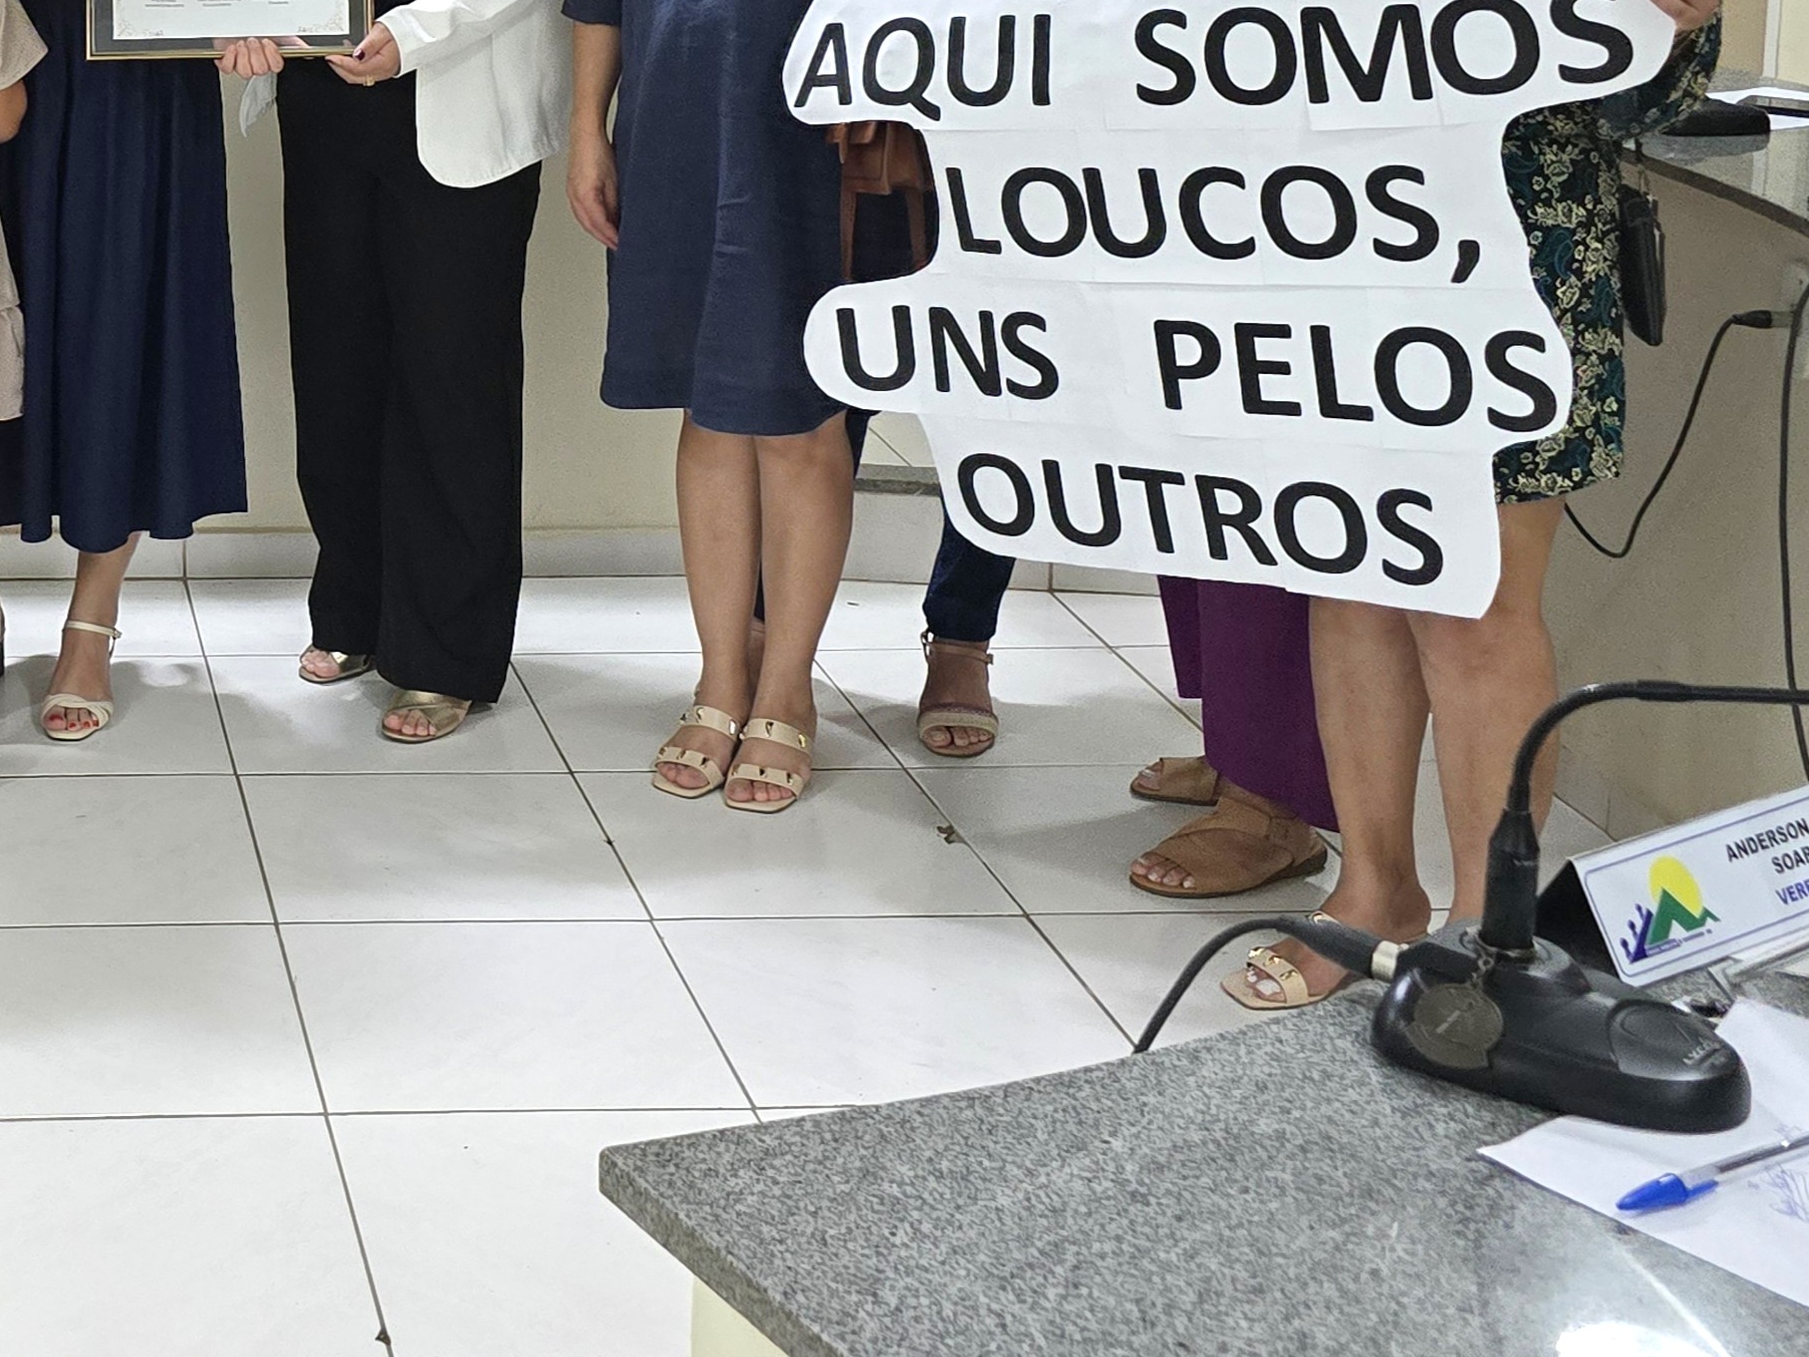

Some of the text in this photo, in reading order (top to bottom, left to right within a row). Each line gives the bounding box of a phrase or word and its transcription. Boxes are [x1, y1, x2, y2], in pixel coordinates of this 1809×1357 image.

[794, 15, 1051, 121] AQUI
[946, 165, 1480, 284] LOUCOS,
[837, 306, 1556, 432] UNS PELOS
[958, 454, 1442, 585] OUTROS
[1725, 817, 1809, 862] ANDERSON
